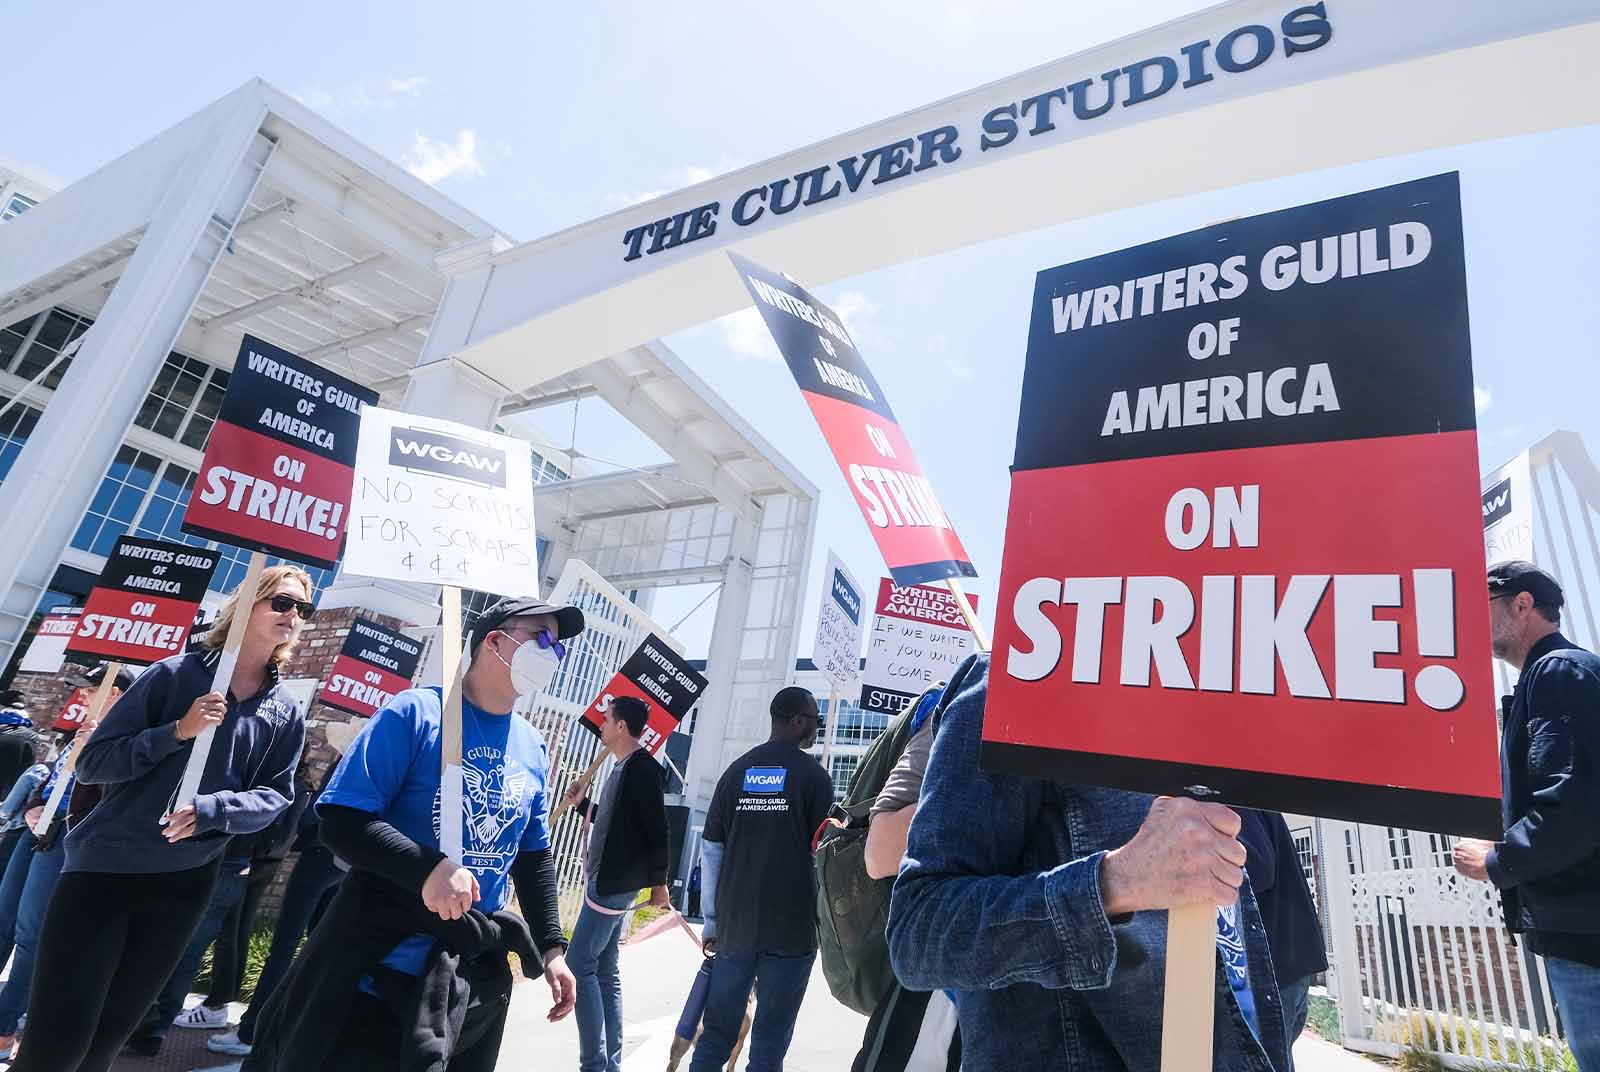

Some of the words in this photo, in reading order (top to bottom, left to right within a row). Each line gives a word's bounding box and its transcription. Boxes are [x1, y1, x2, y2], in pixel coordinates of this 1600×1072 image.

[622, 202, 719, 261] THE
[732, 125, 961, 227] CULVER
[980, 1, 1334, 152] STUDIOS
[1052, 255, 1248, 334] WRITERS
[1260, 221, 1432, 291] GUILD
[747, 274, 823, 329] WRITERS
[1187, 317, 1241, 361] OF
[247, 351, 323, 397] WRITERS
[812, 356, 876, 402] AMERICA
[296, 398, 316, 416] OF
[1100, 362, 1340, 437] AMERICA
[258, 407, 335, 450] AMERICA
[273, 455, 306, 483] ON
[395, 438, 502, 474] WGAW
[200, 465, 344, 540] STRIKE!
[362, 476, 413, 504] NO
[848, 463, 953, 531] STRIK
[360, 515, 422, 549] FOR
[1164, 483, 1260, 551] ON
[119, 543, 175, 563] WRITERS
[175, 554, 213, 570] GUILD
[152, 565, 168, 576] OF
[123, 574, 182, 595] AMERICA
[834, 576, 860, 616] WGAW
[890, 583, 959, 605] WRITER
[130, 601, 157, 618] ON
[884, 603, 967, 626] AMERICA
[890, 594, 944, 612] GUILD
[40, 620, 80, 633] STRIKE
[77, 613, 185, 651] STRIKE!
[355, 623, 394, 645] WRITERS
[394, 639, 418, 656] GUILD
[873, 616, 895, 632] IF
[901, 626, 923, 639] WE
[930, 633, 966, 648] WRITE
[1006, 567, 1464, 711] STRIKE!
[360, 649, 399, 670] AMERICA
[379, 645, 389, 653] OF
[896, 643, 922, 657] YOU
[364, 671, 382, 684] ON
[643, 644, 678, 676] WRITERS
[675, 672, 698, 694] GUILD
[658, 674, 669, 684] OF
[887, 662, 933, 682] COME
[328, 674, 395, 708] STRIKE
[637, 673, 673, 705] AMERICA
[468, 746, 501, 760] GUILD
[746, 775, 784, 785] WGAW
[472, 858, 495, 866] WEST
